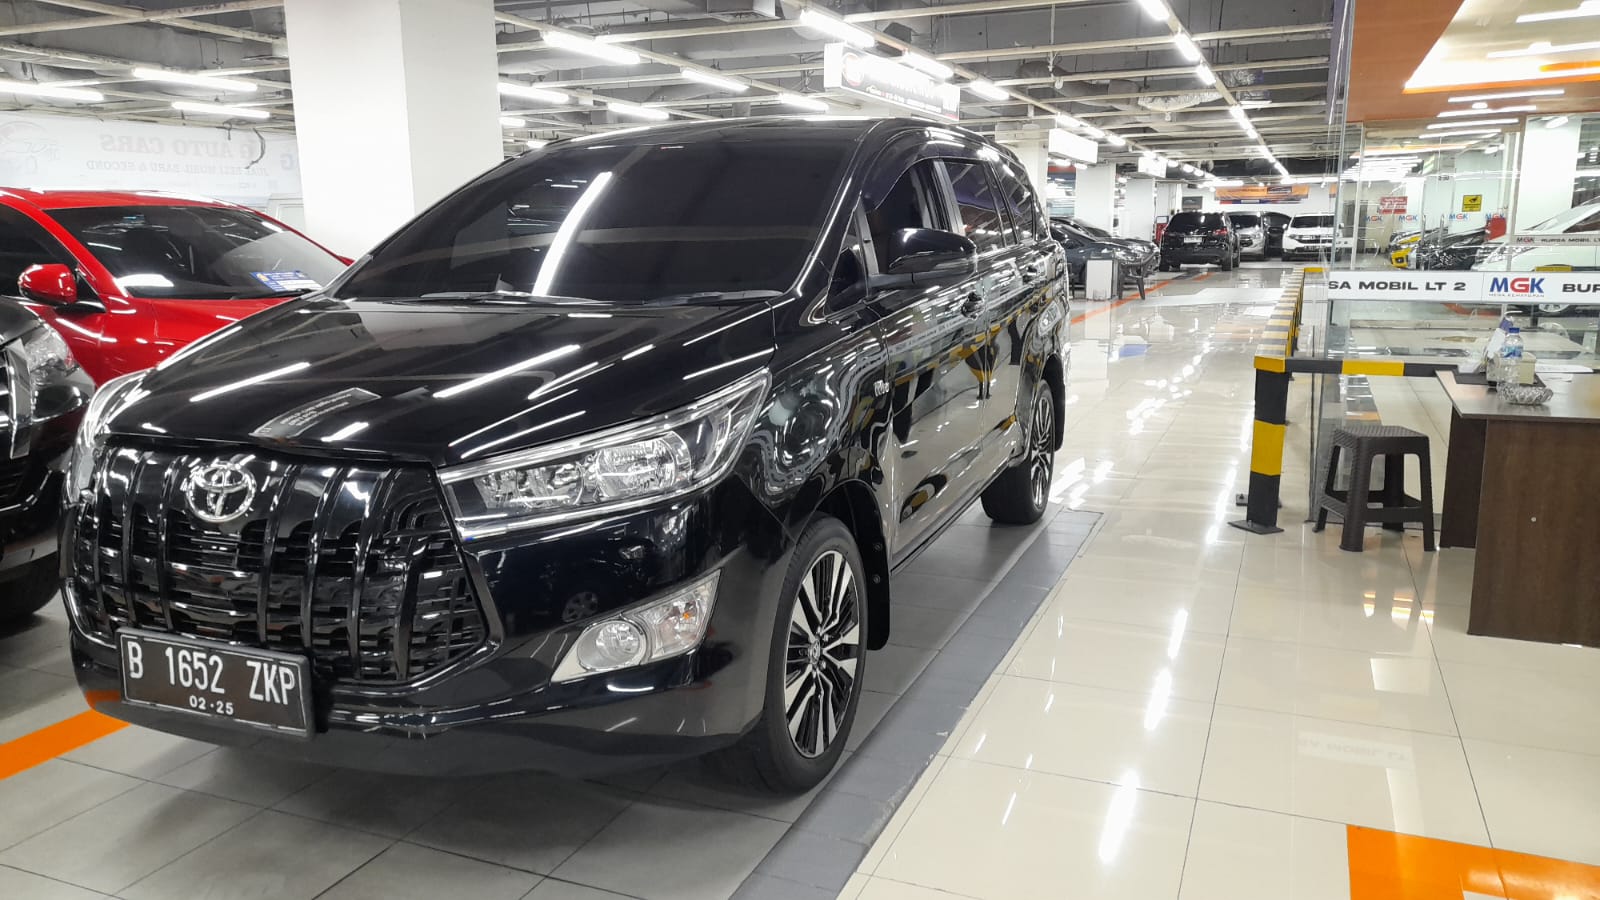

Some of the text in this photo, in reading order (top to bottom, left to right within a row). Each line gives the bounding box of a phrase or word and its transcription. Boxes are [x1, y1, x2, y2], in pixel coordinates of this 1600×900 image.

[1449, 213, 1469, 221] MGK
[1358, 281, 1418, 290] MOBIL
[1425, 282, 1447, 291] LT
[1453, 282, 1466, 291] 2
[1490, 277, 1545, 293] MGK
[127, 640, 296, 705] B 1652 ZKP
